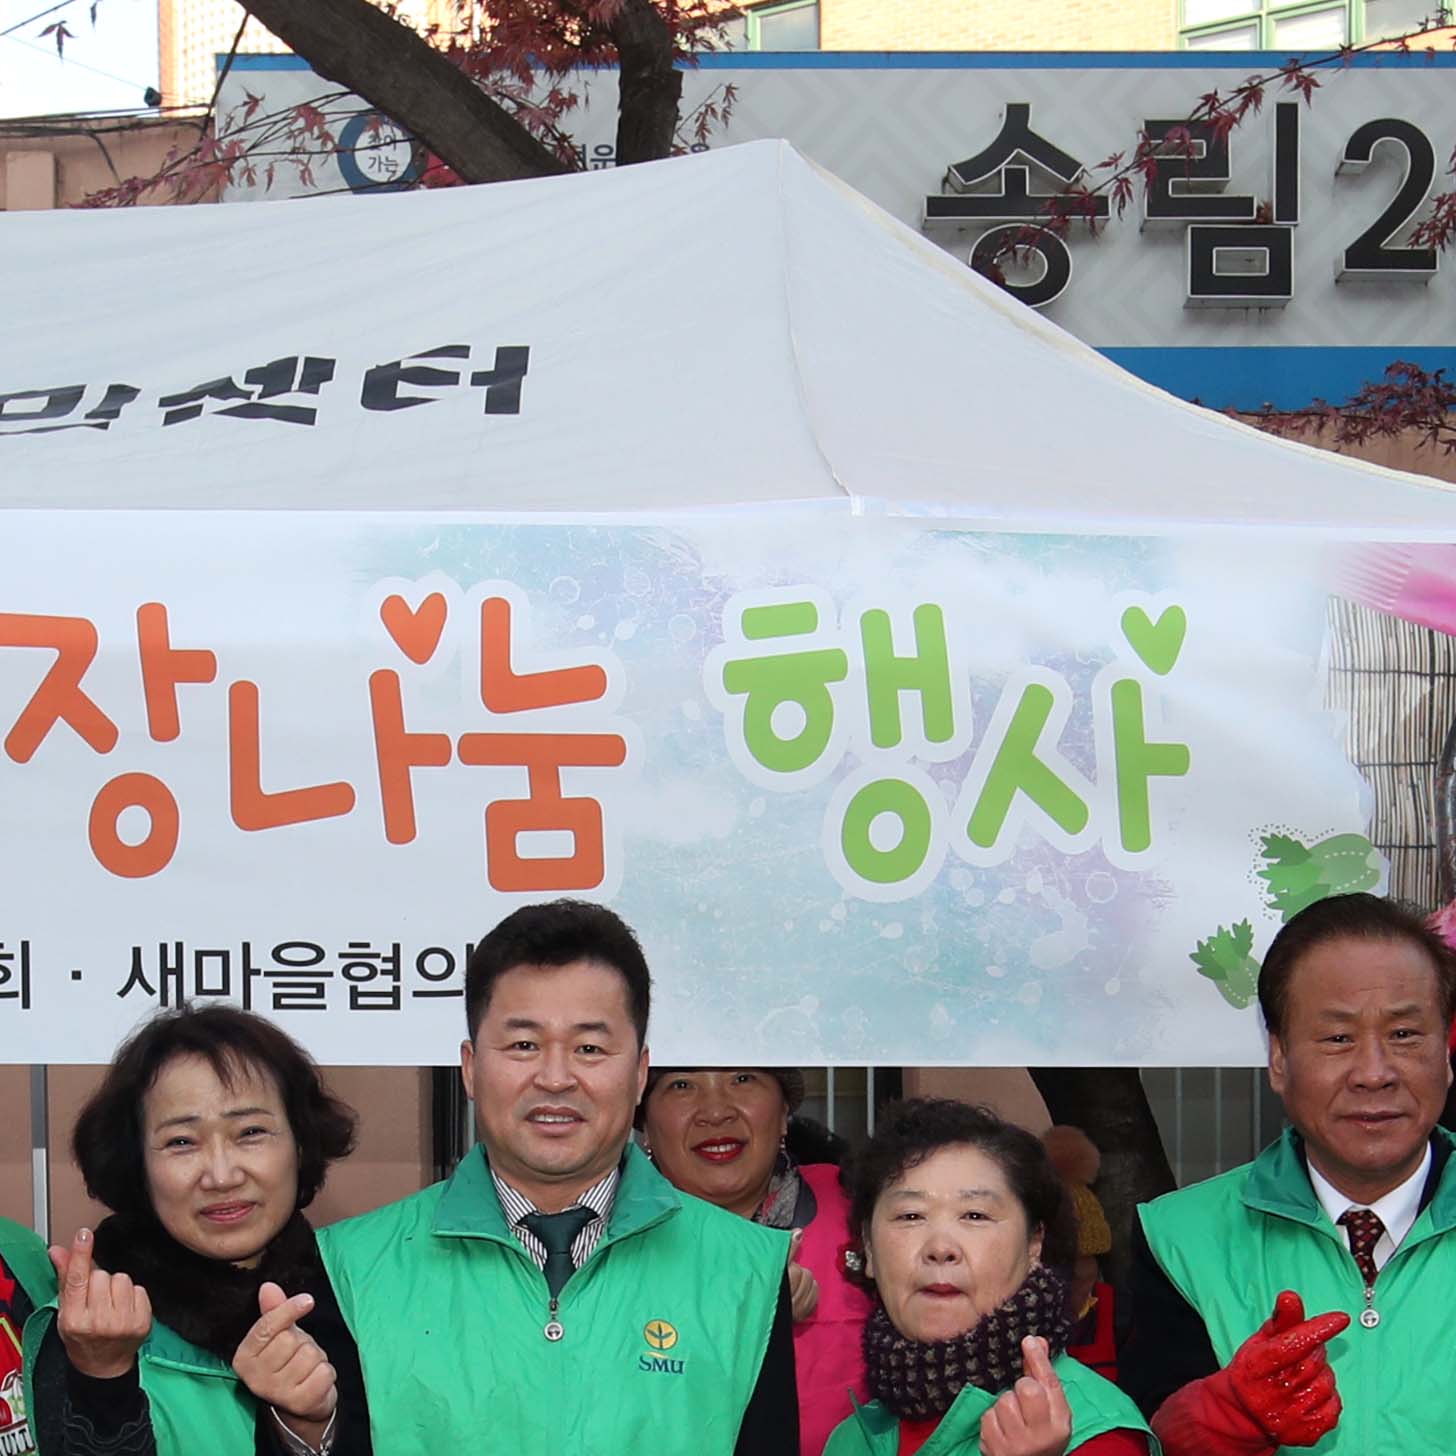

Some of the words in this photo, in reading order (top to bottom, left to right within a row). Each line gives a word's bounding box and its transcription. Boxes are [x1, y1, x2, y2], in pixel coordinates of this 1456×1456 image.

[367, 154, 399, 174] 가는
[724, 601, 1191, 885] 행사
[638, 1355, 685, 1375] SMU
